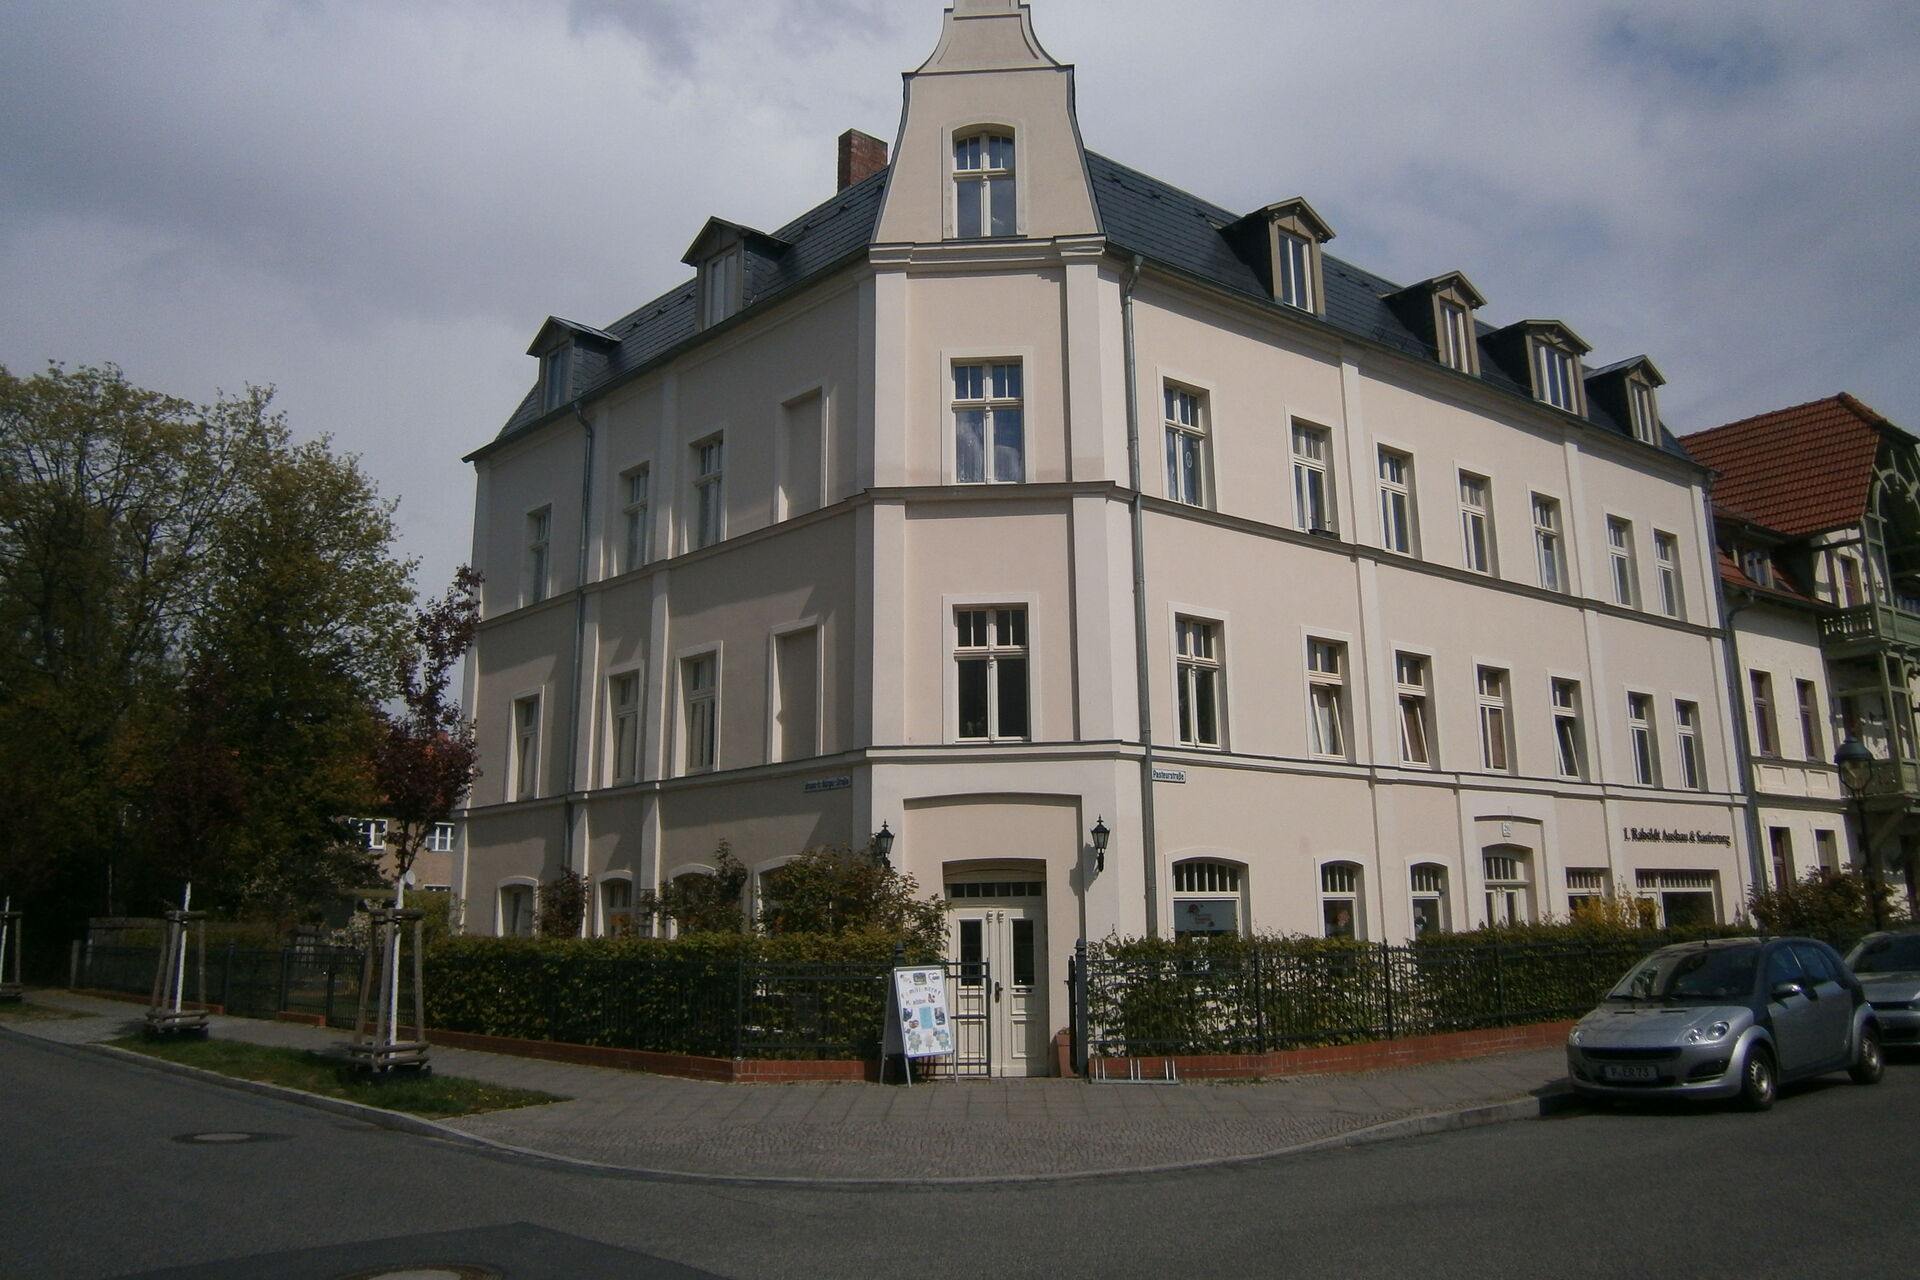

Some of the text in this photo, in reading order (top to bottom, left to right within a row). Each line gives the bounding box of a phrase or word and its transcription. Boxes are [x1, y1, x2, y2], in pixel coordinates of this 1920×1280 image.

[1153, 769, 1184, 780] Pasteurstraße
[1662, 829, 1688, 842] Ausbau
[1689, 830, 1696, 843] &
[1696, 830, 1731, 848] Sanierung
